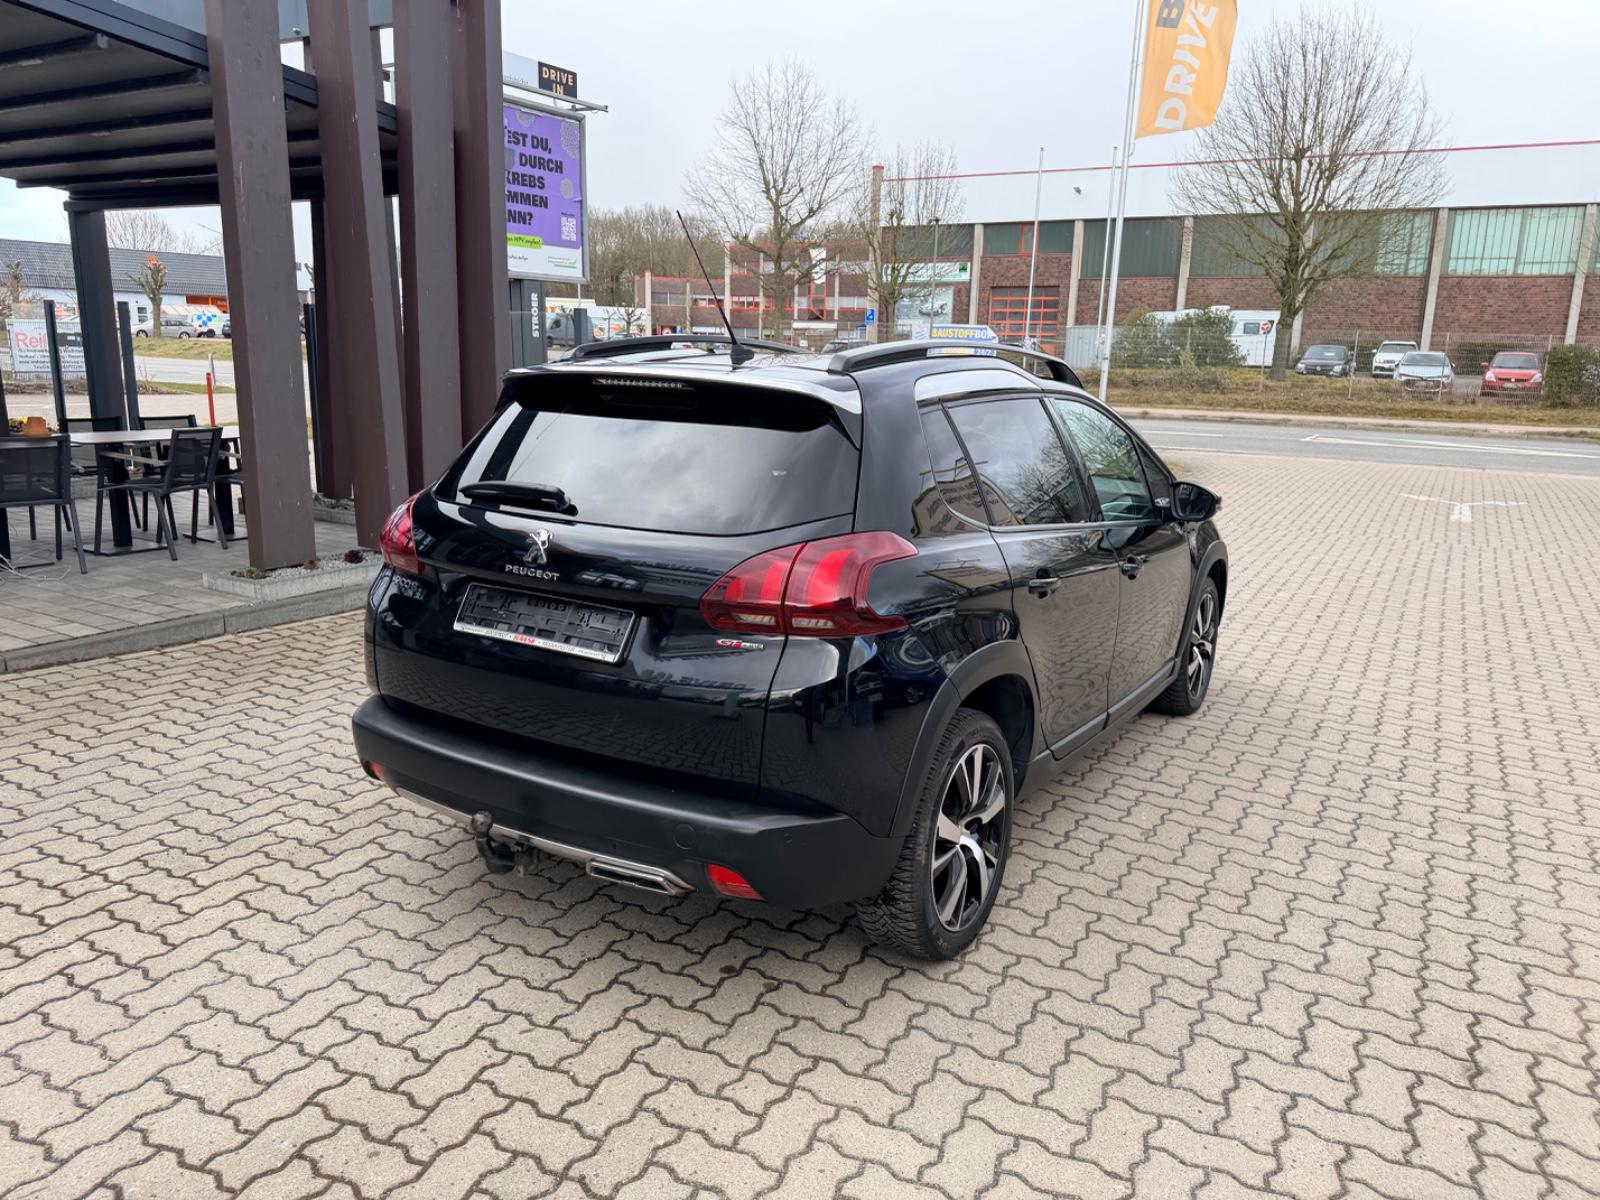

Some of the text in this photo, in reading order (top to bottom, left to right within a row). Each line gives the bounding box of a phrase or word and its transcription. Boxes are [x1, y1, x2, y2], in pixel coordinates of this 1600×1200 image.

[1154, 0, 1218, 131] DRIVE
[542, 66, 574, 86] DRIVE
[552, 82, 565, 97] IN
[531, 135, 552, 154] DU,
[519, 152, 564, 174] DURCH
[506, 190, 548, 209] MMEN
[507, 208, 533, 226] NN?
[505, 564, 560, 581] PEUGEOT
